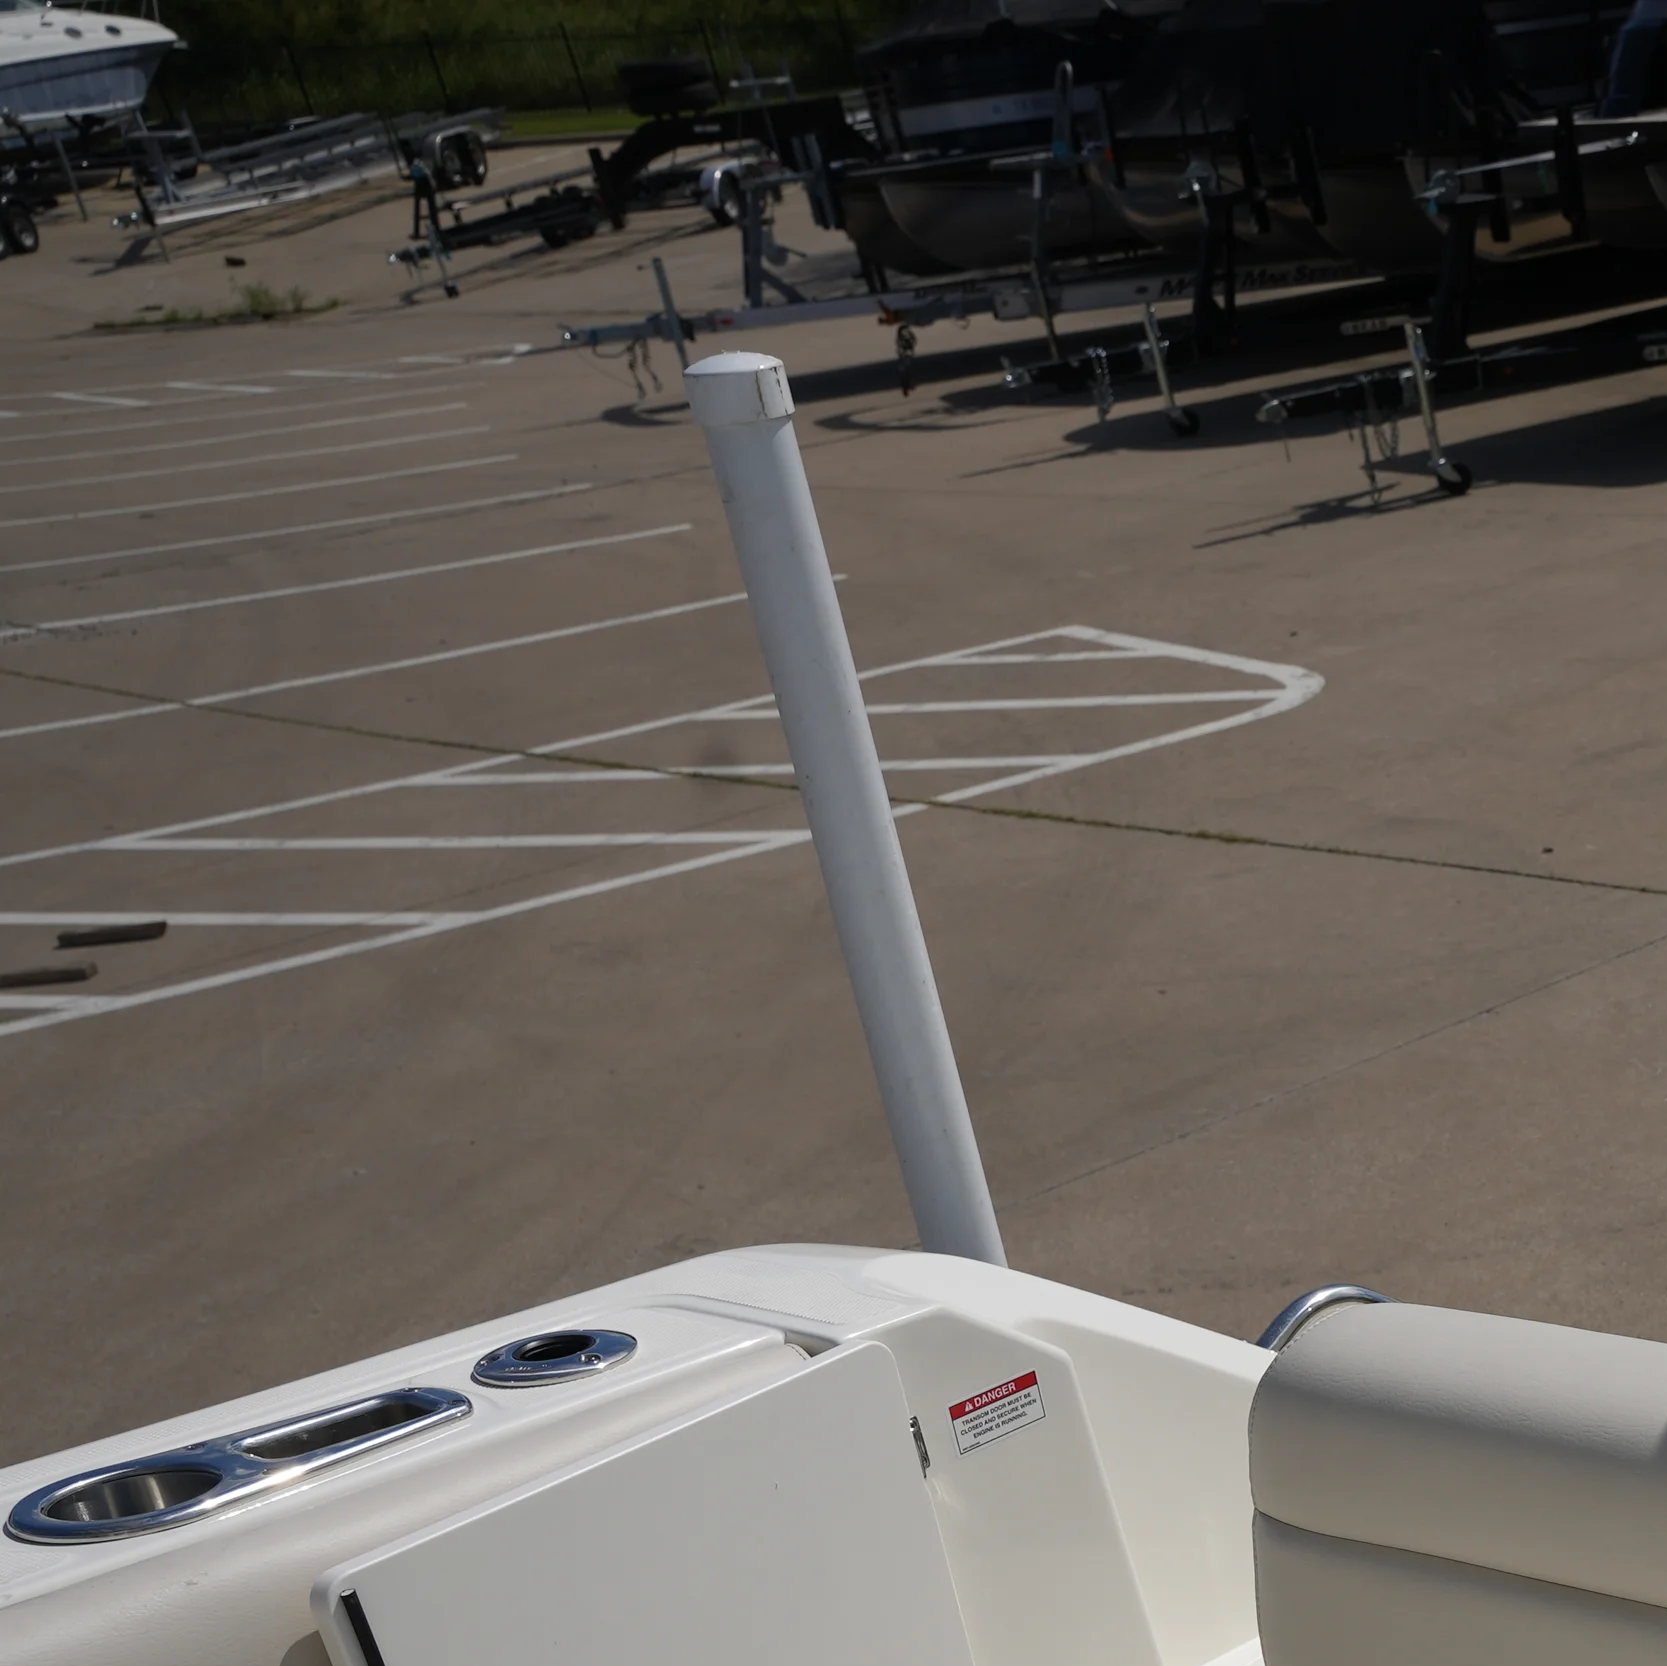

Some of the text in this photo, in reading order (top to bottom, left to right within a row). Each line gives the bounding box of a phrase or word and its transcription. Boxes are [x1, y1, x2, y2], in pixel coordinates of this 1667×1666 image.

[961, 1392, 1032, 1427] TRANSOM DOOR MUST BE
[974, 1382, 1016, 1408] DANGER
[960, 1398, 1037, 1436] CLOSED AND SECURE WHEN
[973, 1425, 995, 1439] ENGINE
